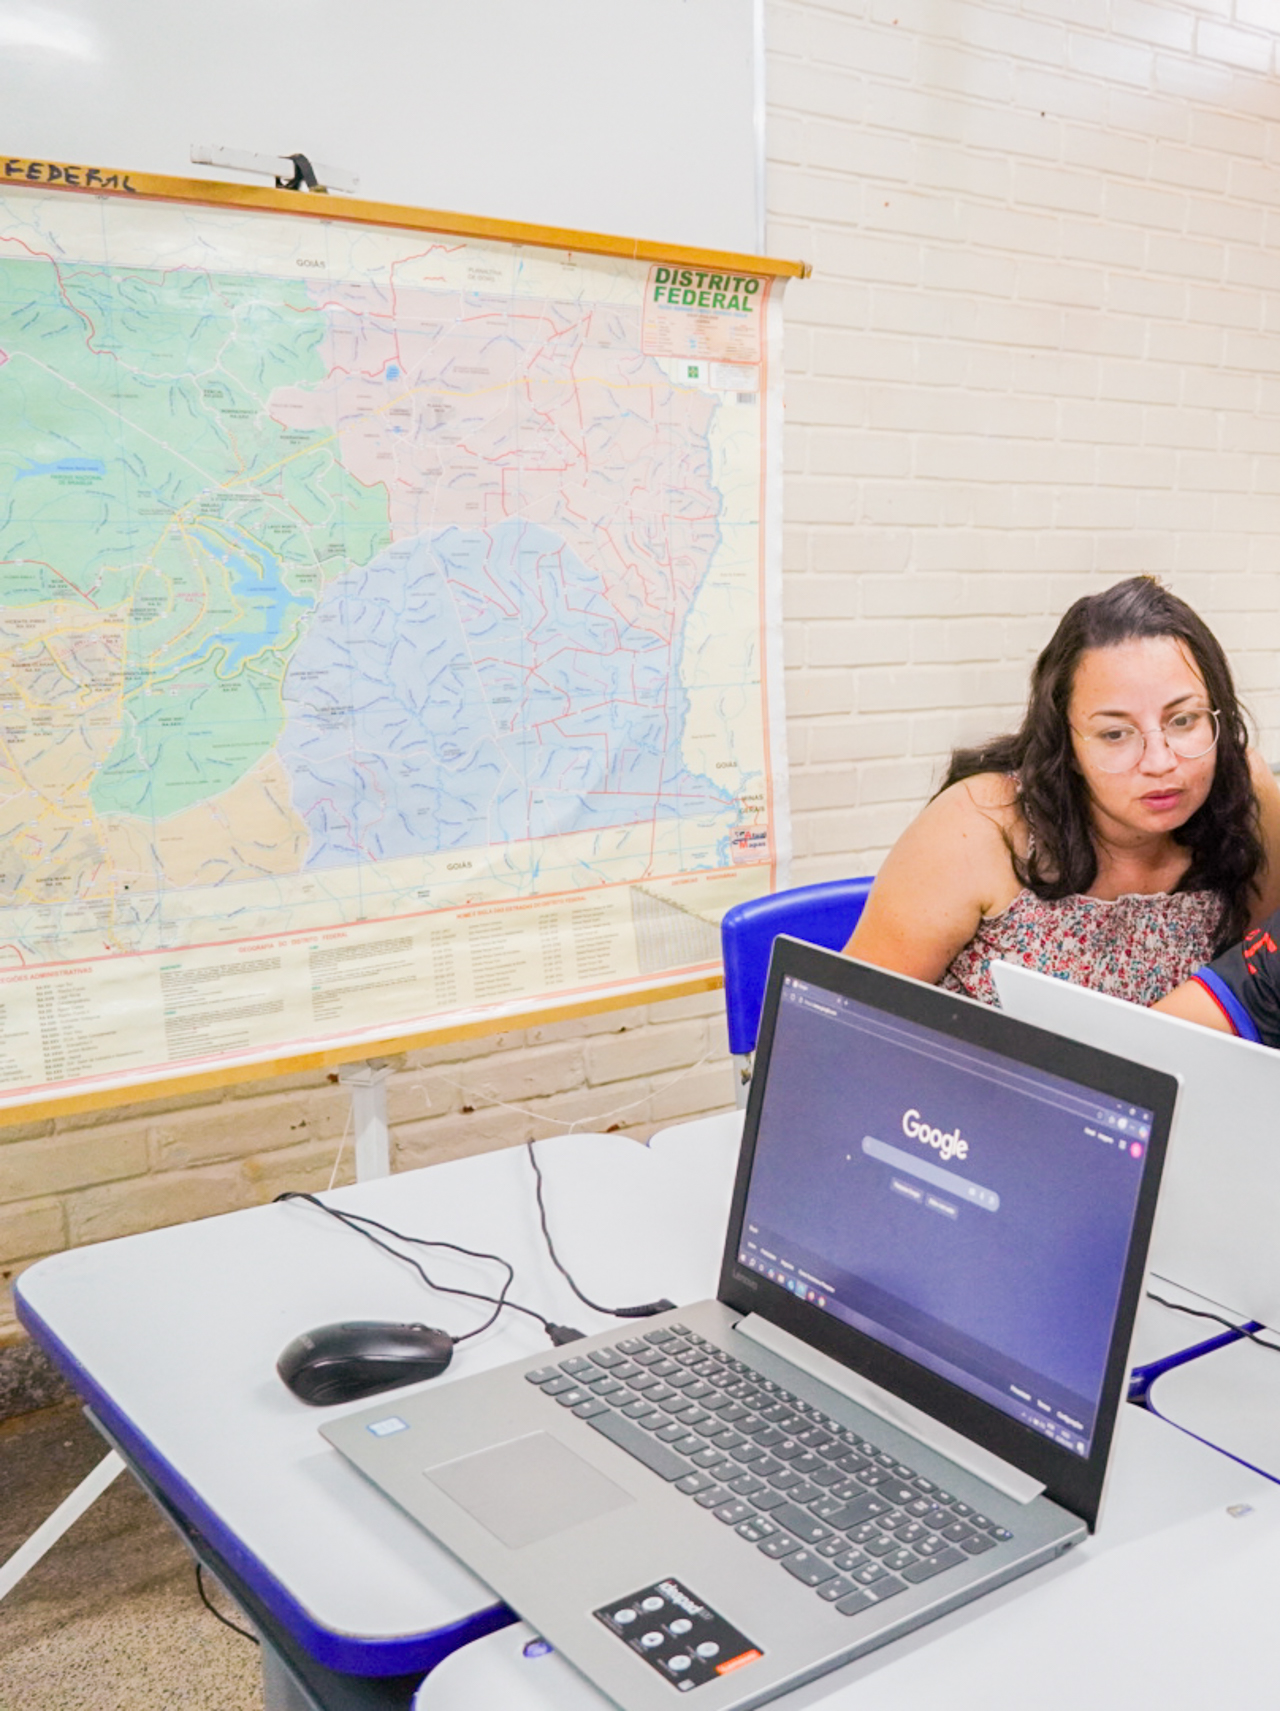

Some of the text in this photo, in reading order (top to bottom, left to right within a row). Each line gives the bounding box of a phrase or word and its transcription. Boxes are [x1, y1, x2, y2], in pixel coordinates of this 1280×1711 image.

[5, 159, 137, 193] FEDERAL
[655, 267, 760, 294] DISTRITO
[653, 286, 753, 312] FEDERAL
[902, 1108, 970, 1161] Google
